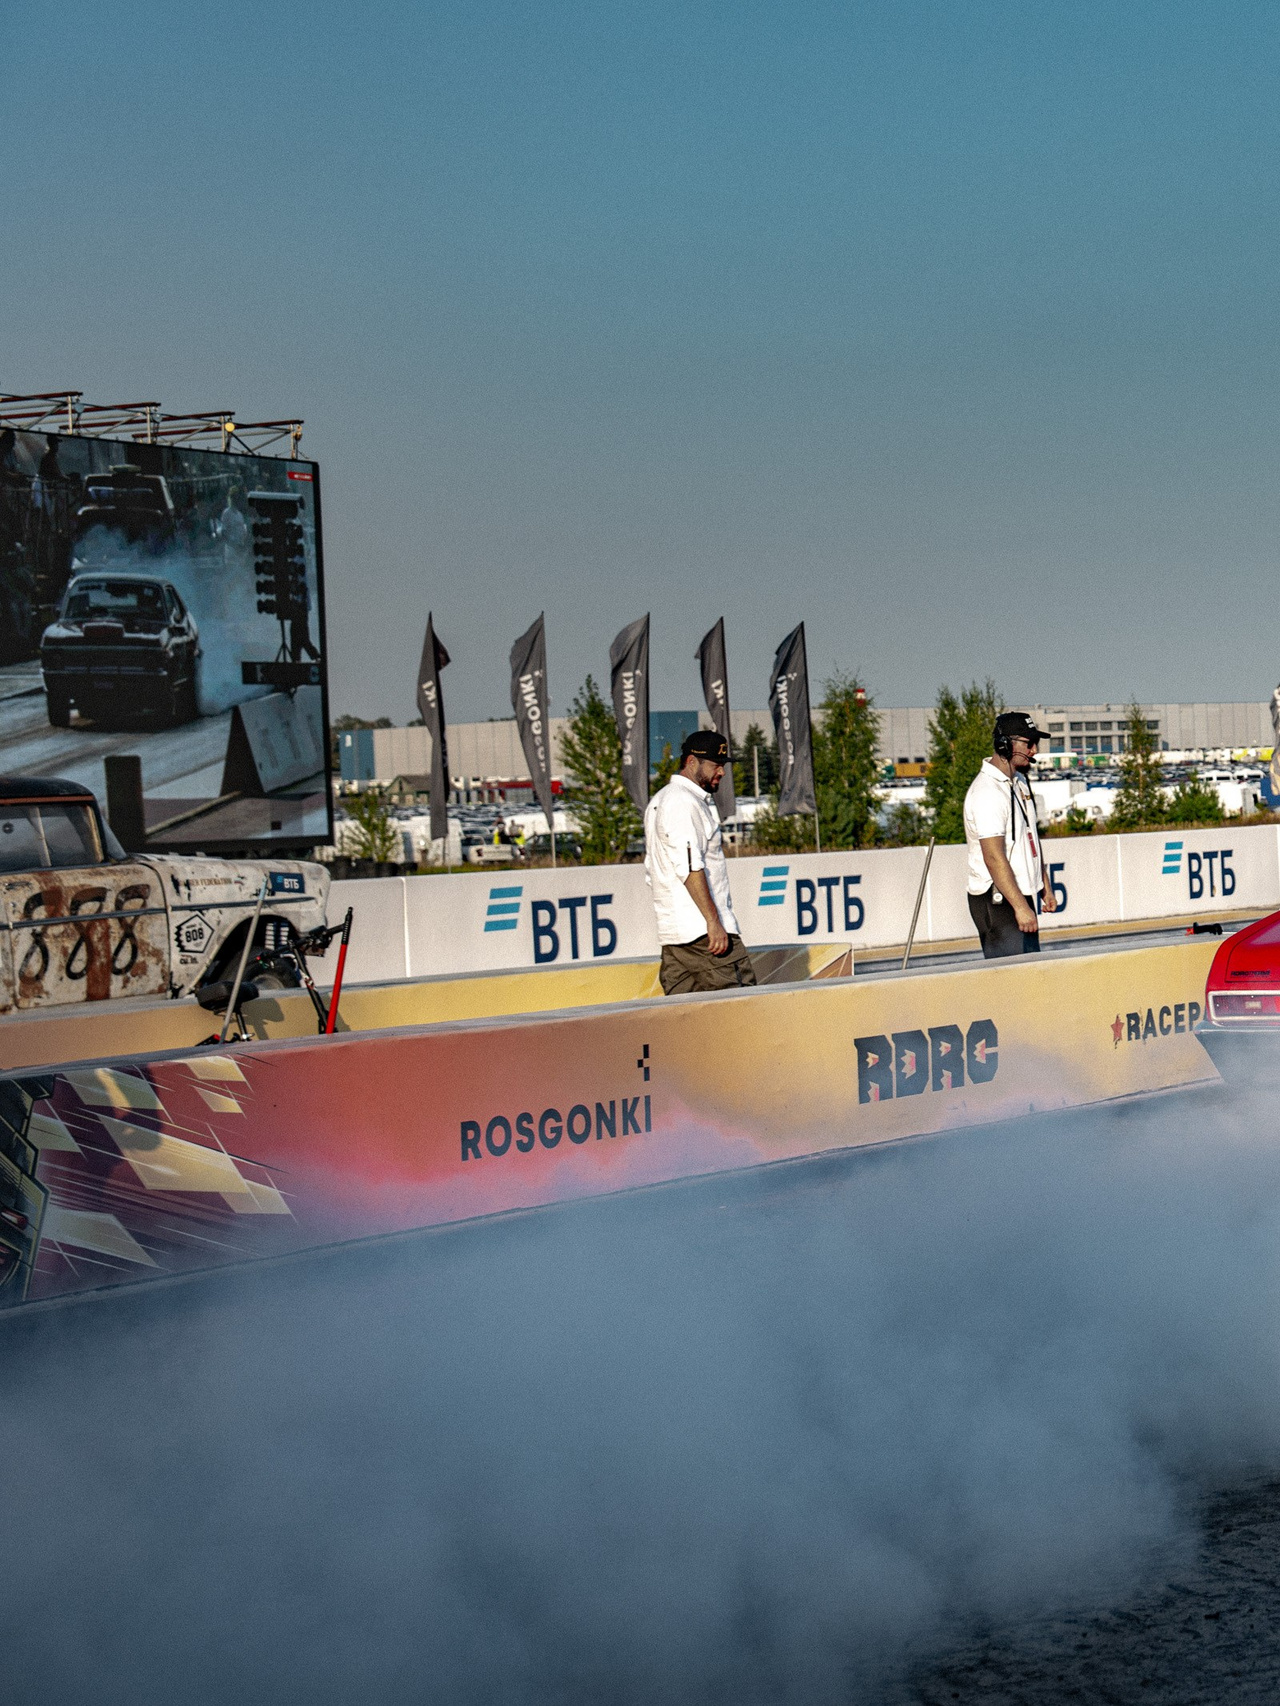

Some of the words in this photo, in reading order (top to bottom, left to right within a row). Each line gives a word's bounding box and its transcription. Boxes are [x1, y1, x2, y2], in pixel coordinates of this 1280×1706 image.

[795, 874, 865, 936] ВТБ
[1188, 849, 1236, 900] ВТБ
[531, 893, 618, 964] ВТБ
[1126, 1001, 1207, 1042] RACEP
[854, 1018, 999, 1105] RDRC
[460, 1094, 652, 1162] ROSGONKI
